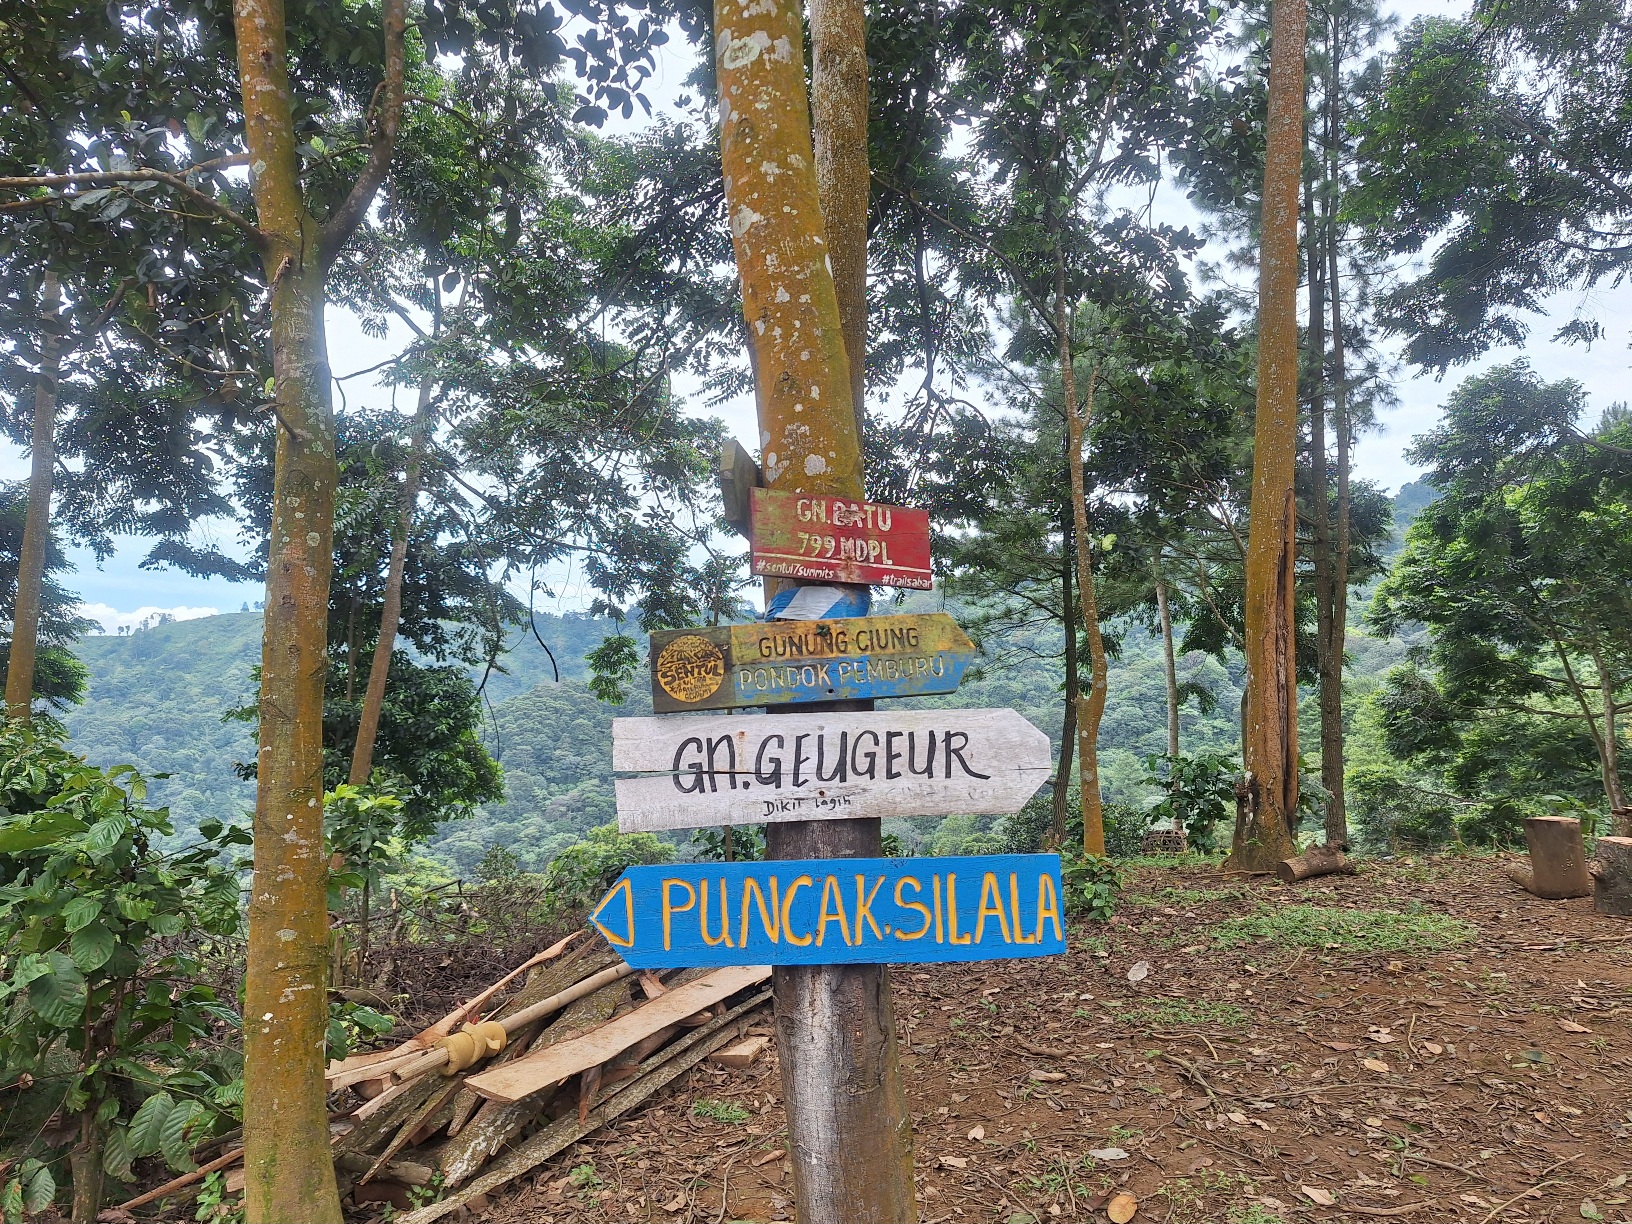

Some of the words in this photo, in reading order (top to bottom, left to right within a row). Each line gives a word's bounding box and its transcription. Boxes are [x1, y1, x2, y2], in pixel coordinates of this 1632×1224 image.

[797, 532, 835, 558] 799
[756, 559, 835, 579] #sentul7summits
[881, 573, 932, 589] #trailsabar
[759, 631, 848, 658] GUNUNG
[856, 627, 919, 651] CIUNG
[660, 663, 723, 686] SENTUL
[740, 663, 831, 691] PONDOK
[837, 655, 944, 684] PEMBURU
